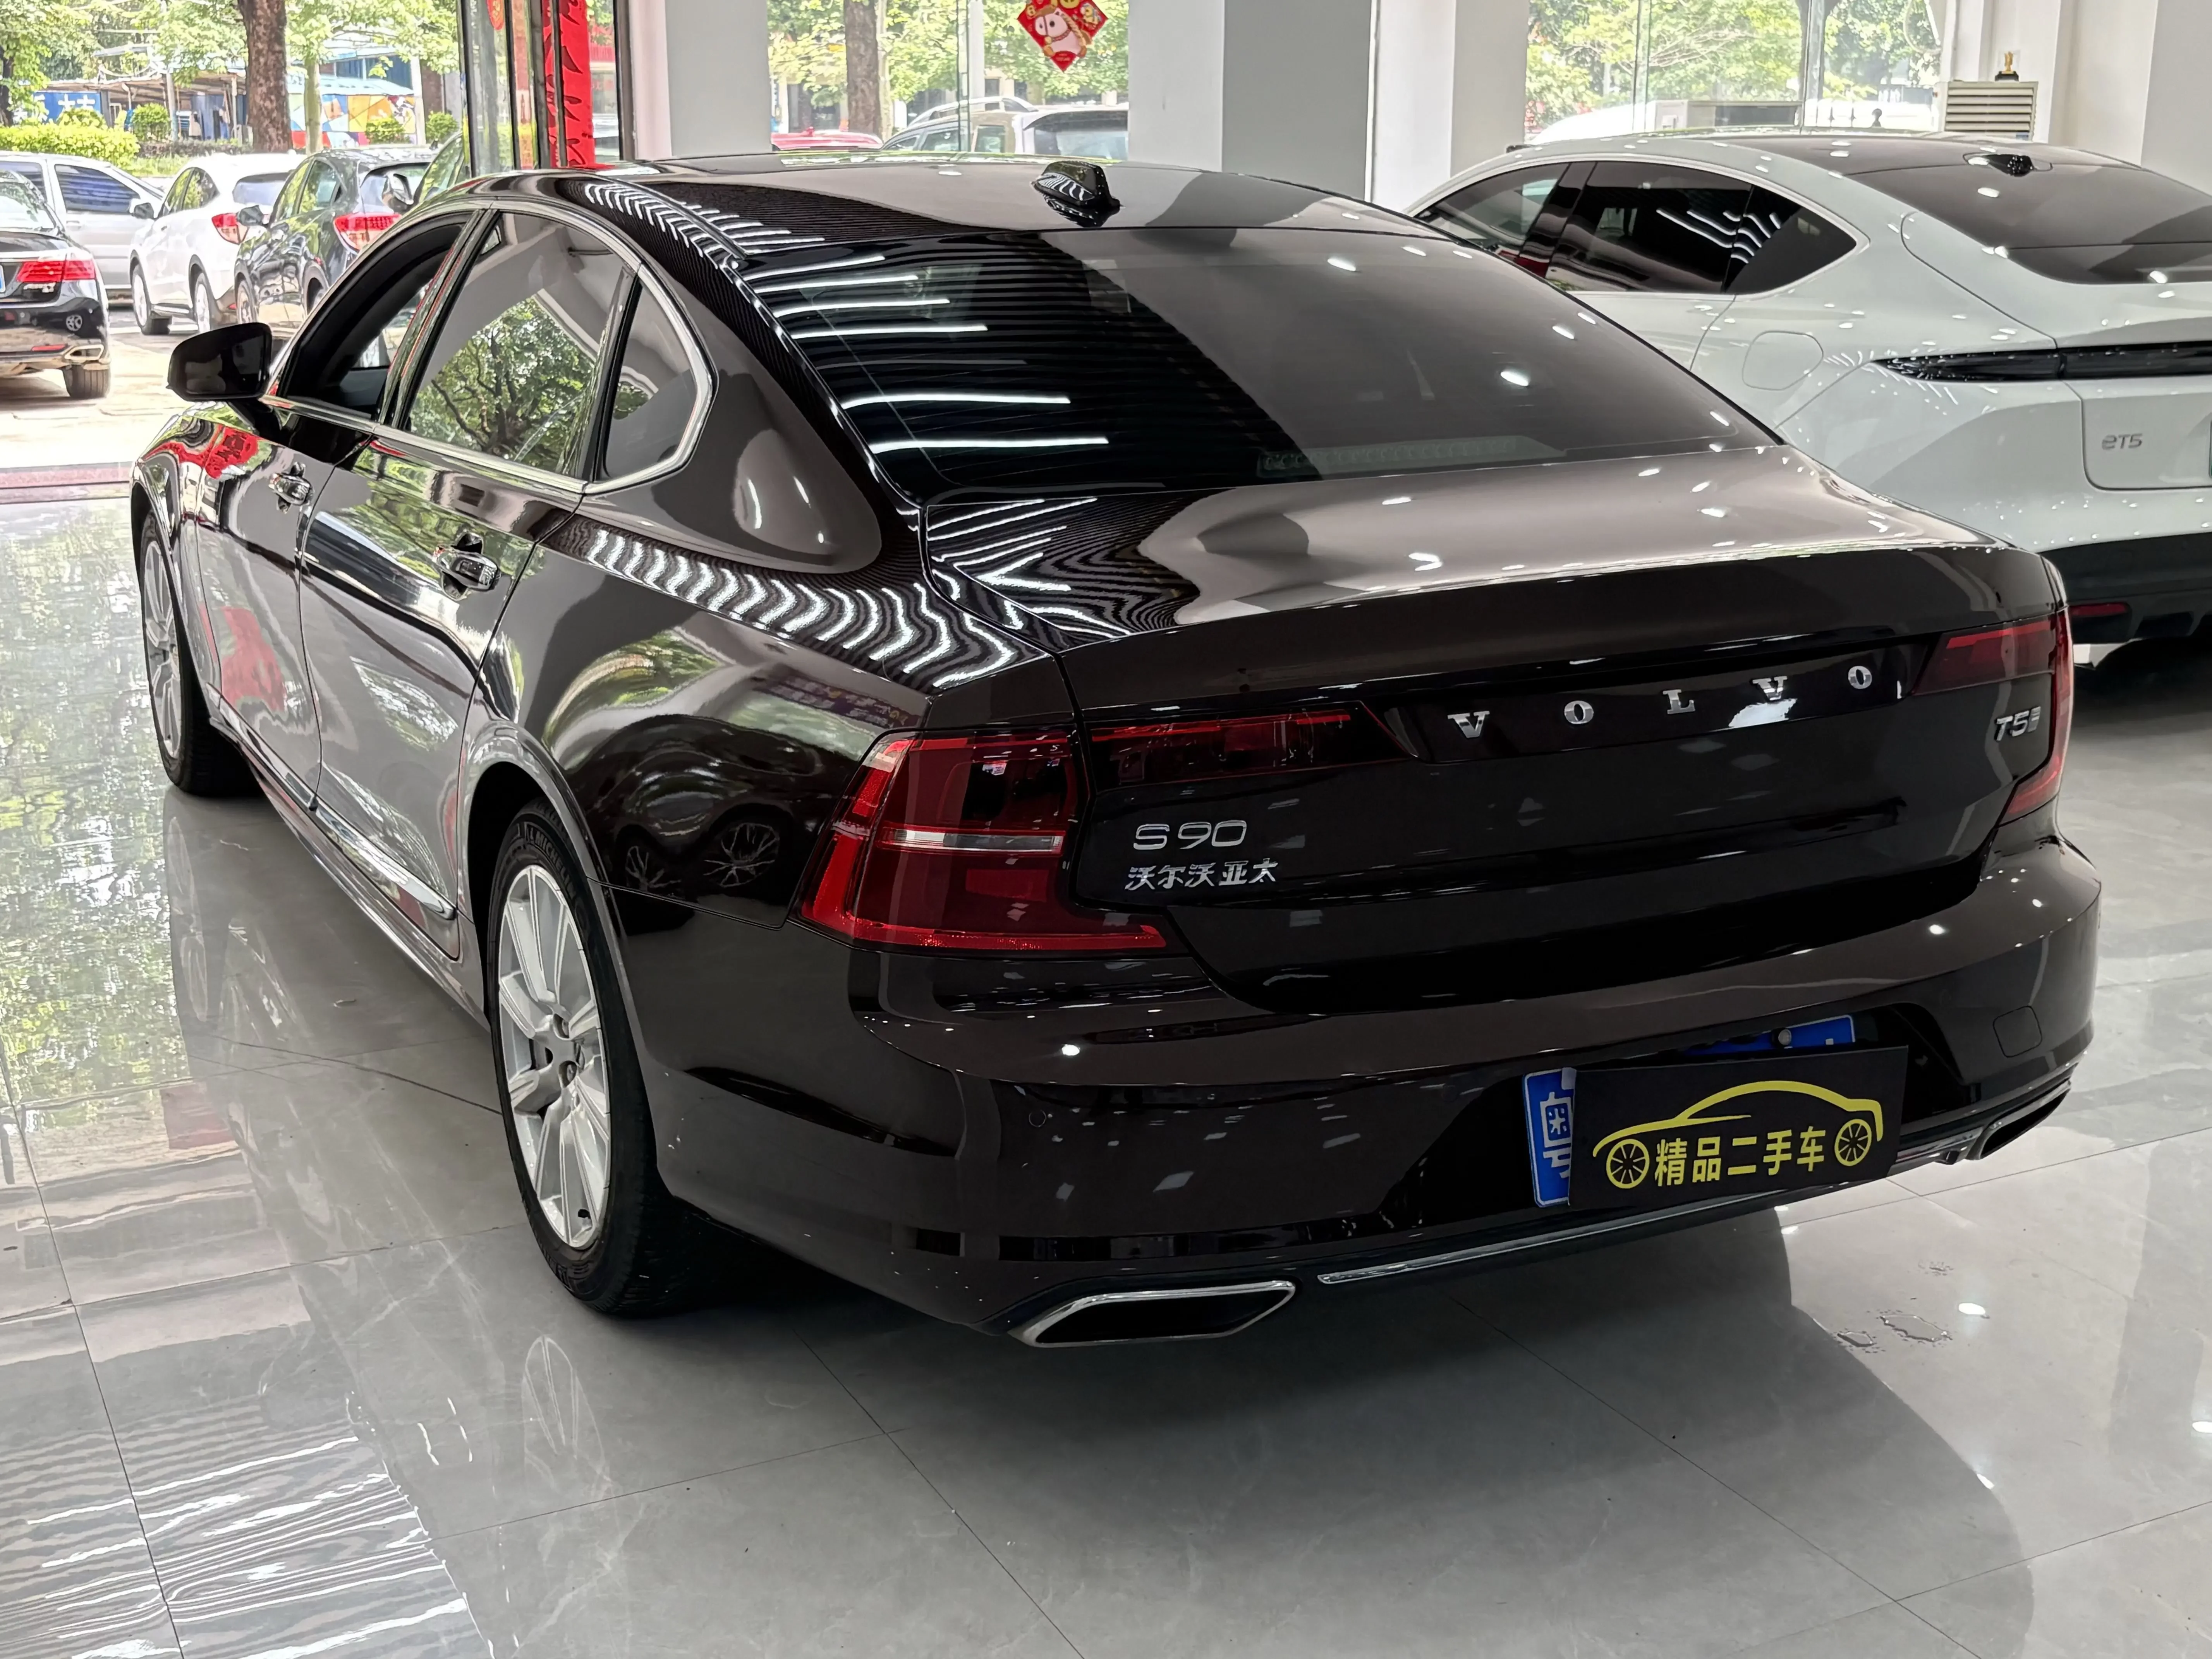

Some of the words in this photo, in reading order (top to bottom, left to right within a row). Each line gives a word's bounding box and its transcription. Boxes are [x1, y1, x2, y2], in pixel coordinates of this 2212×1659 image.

[1448, 665, 1873, 740] VOLVO
[535, 833, 577, 901] MICHELIN
[1125, 858, 1278, 891] 沃尔沃亚太
[1655, 1126, 1825, 1186] 精品二手车
